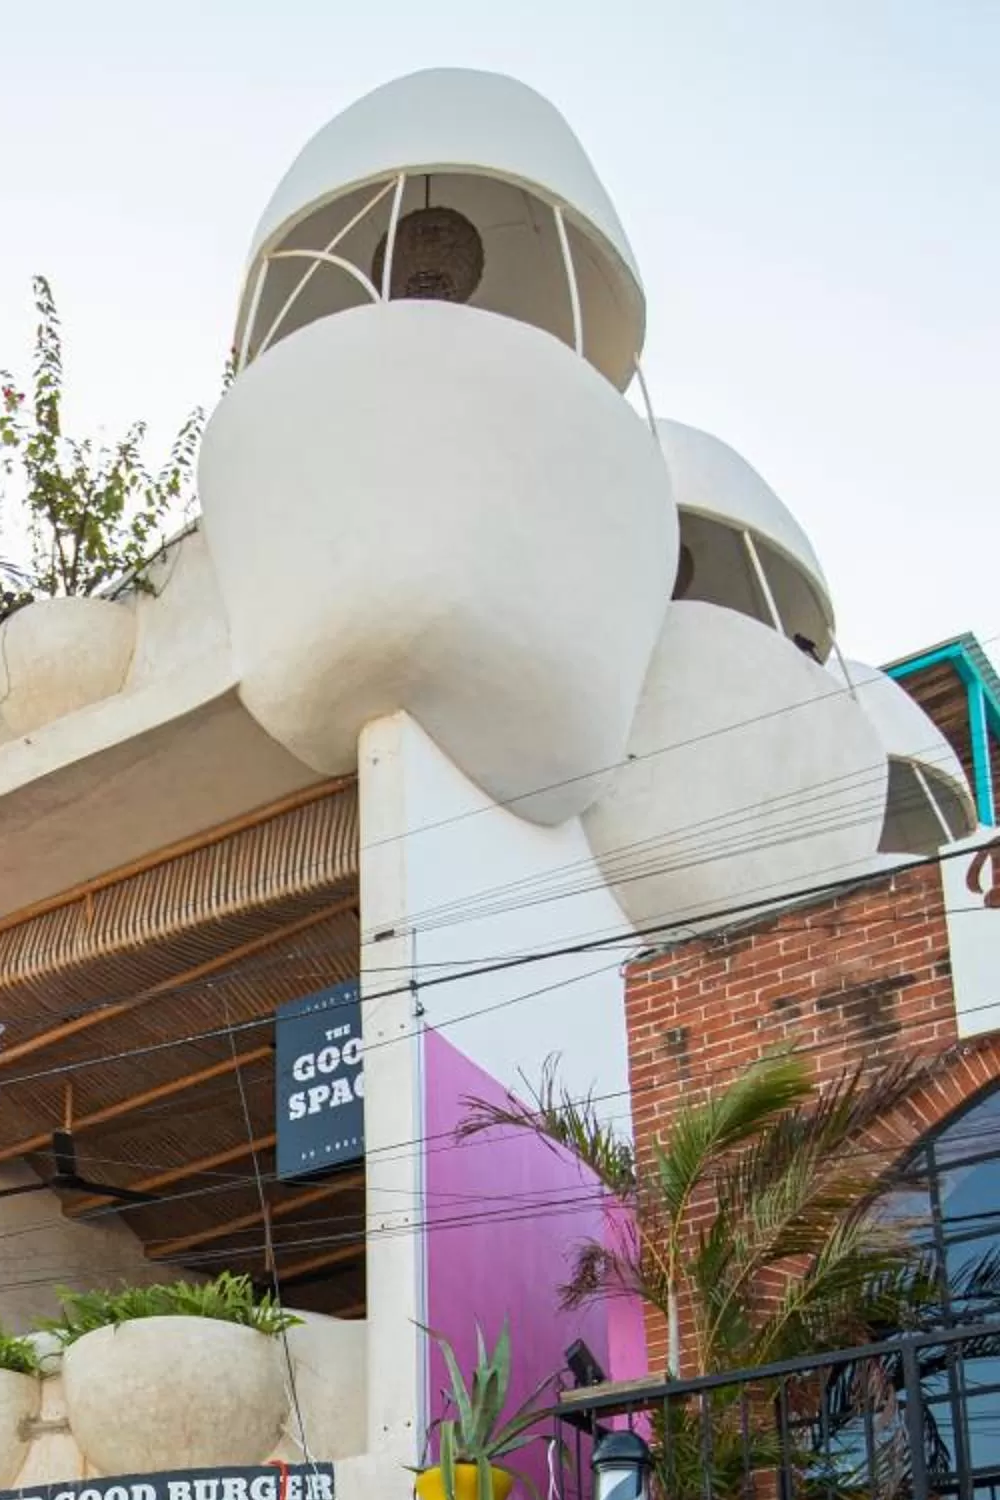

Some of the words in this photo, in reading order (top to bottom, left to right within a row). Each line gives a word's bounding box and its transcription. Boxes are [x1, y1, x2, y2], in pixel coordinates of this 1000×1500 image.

[325, 1023, 351, 1041] THE
[293, 1037, 364, 1081] GOO
[288, 1072, 365, 1121] SPAC
